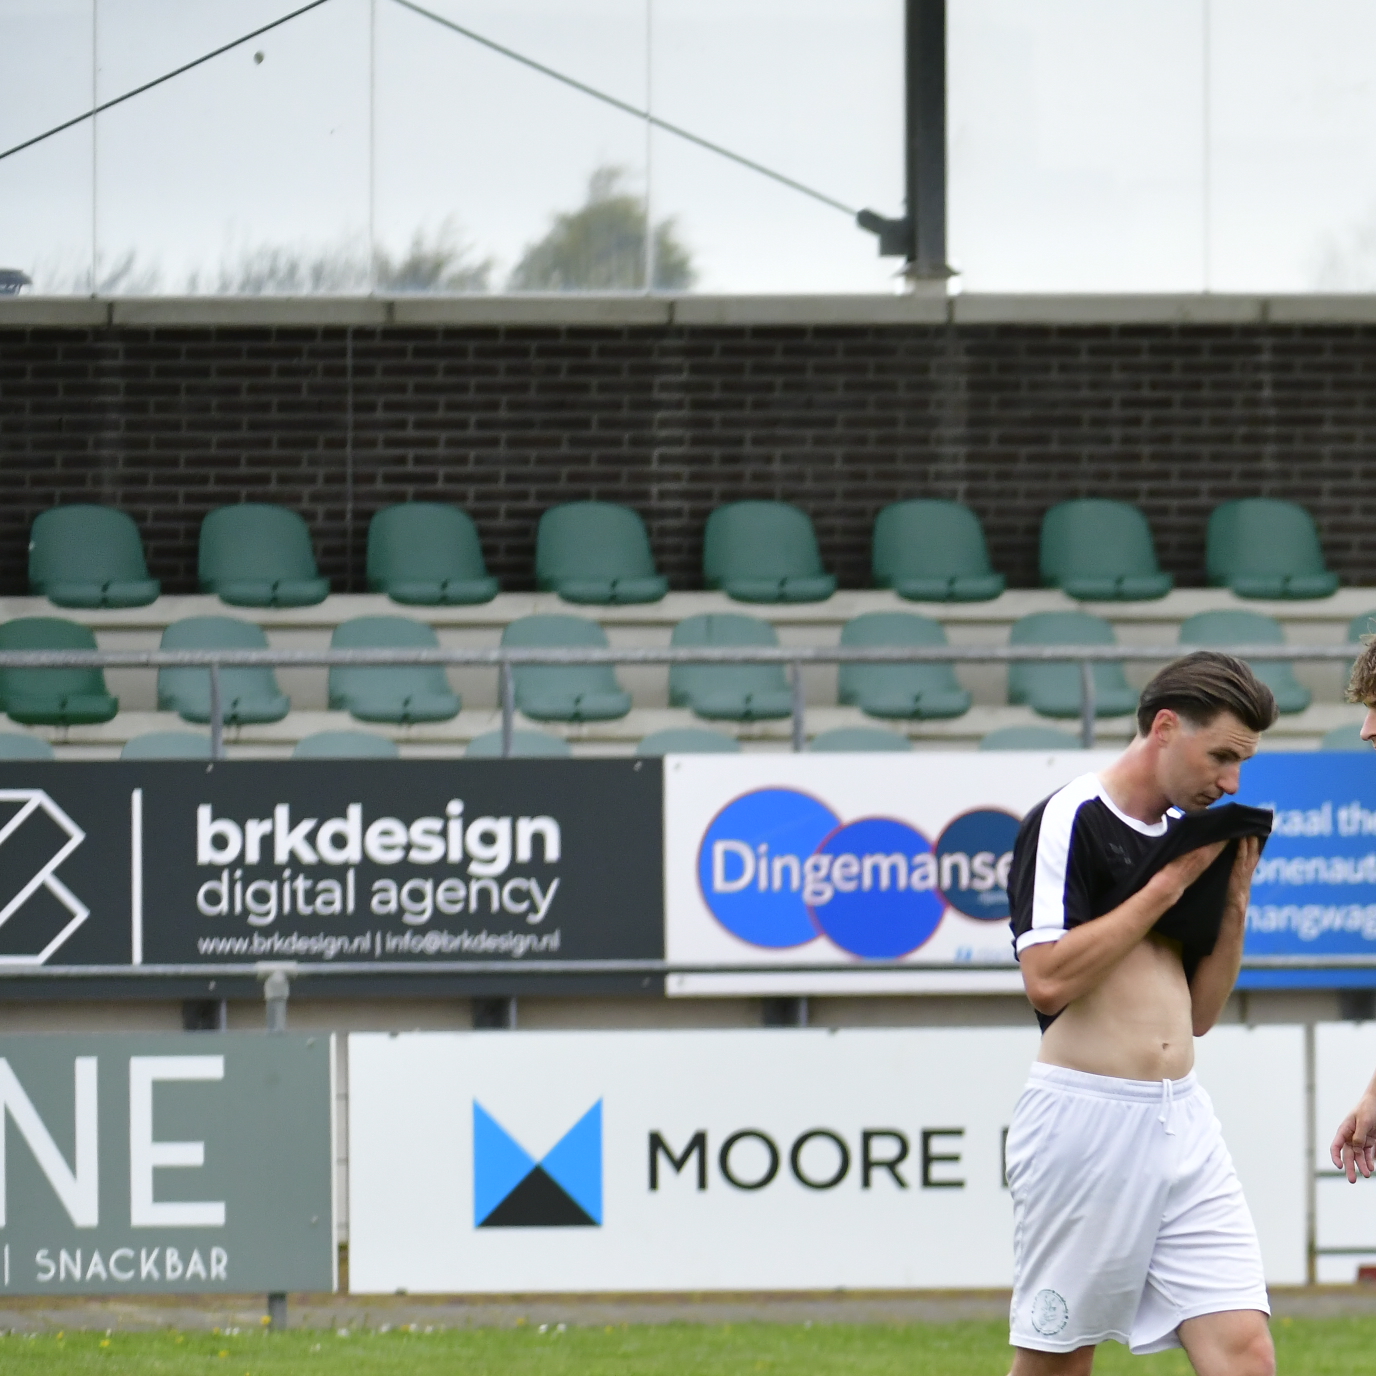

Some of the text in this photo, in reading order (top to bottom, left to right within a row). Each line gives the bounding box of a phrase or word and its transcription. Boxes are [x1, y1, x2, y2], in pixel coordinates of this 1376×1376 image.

[196, 798, 561, 875] brkdesign
[196, 868, 561, 926] digital agency
[197, 929, 562, 961] www.brkdesign.nl info@brkdesign.nl
[648, 1127, 966, 1193] MOORE
[34, 1246, 229, 1283] SNACKBAR
